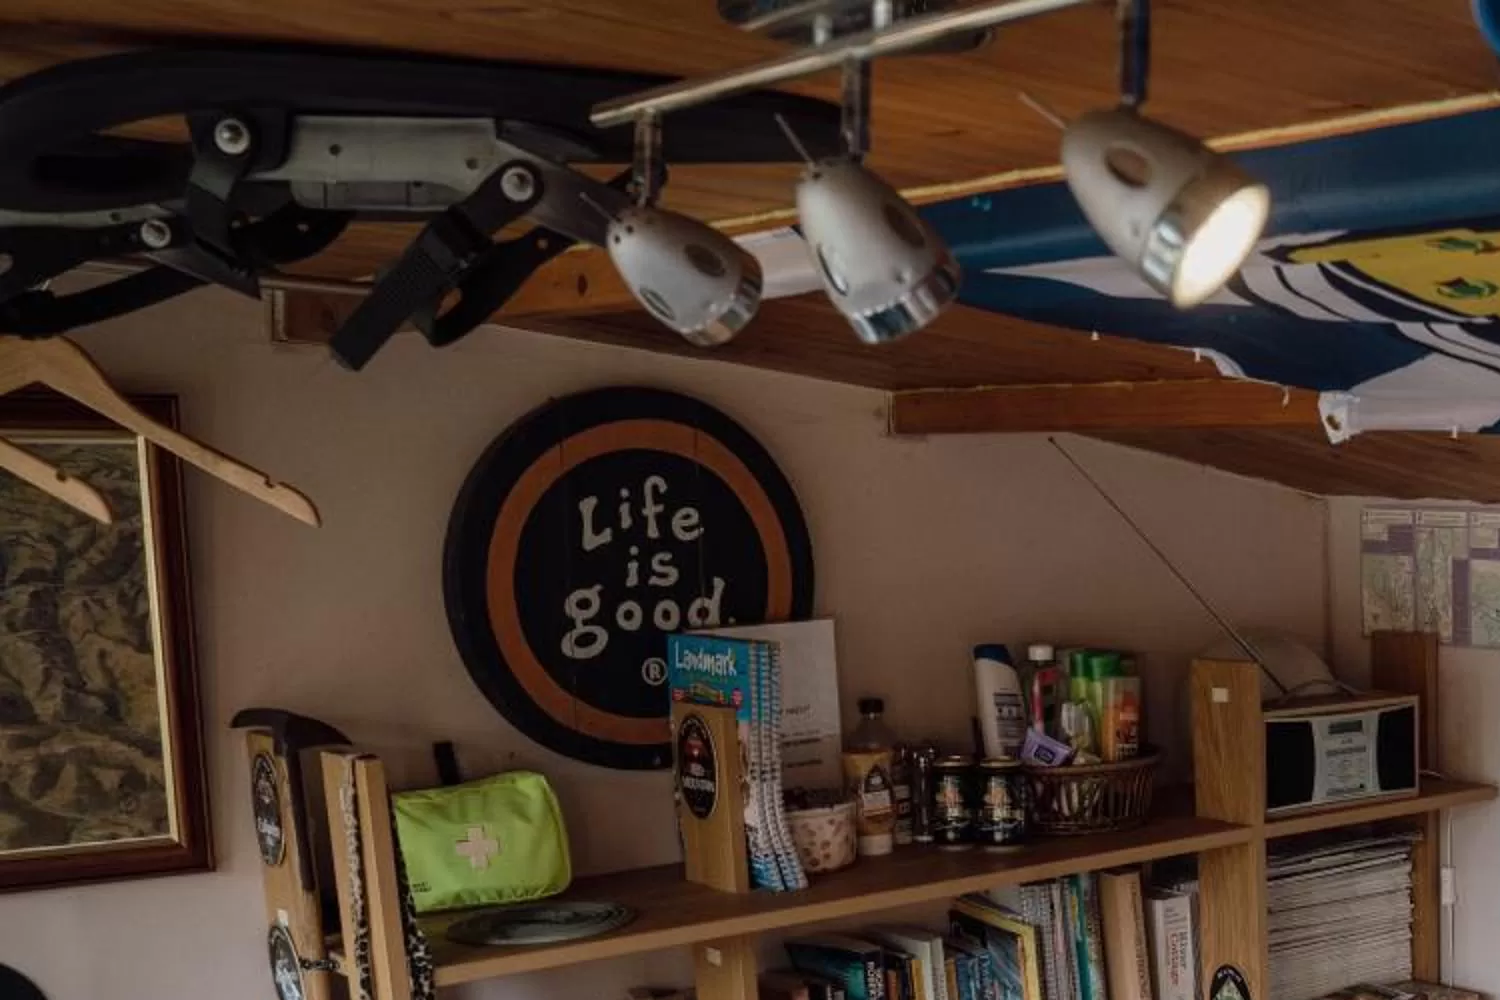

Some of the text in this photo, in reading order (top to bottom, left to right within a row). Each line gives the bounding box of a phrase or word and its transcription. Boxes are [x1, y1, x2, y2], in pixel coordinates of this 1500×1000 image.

[578, 475, 704, 551] Life
[625, 545, 679, 587] is
[675, 641, 738, 676] Landmark
